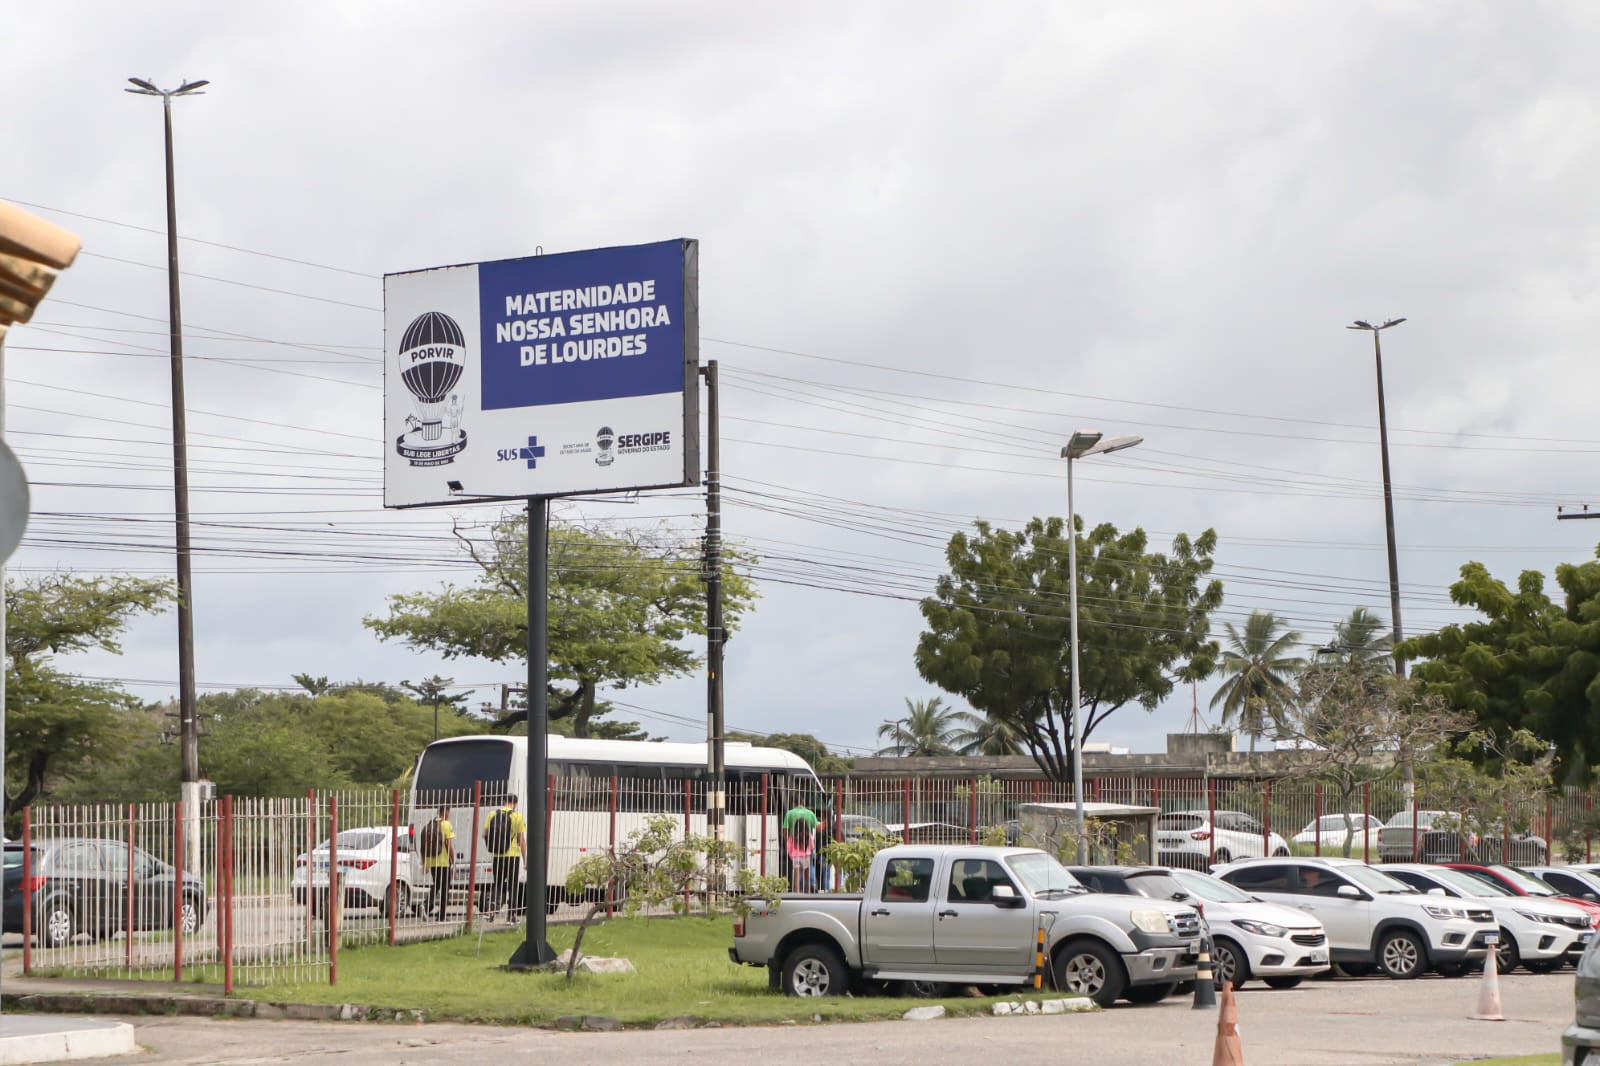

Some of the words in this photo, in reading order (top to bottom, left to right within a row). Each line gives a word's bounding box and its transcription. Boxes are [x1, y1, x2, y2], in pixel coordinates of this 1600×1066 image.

[505, 279, 655, 316] MATERNIDADE
[496, 316, 566, 343] NOSSA
[570, 305, 670, 334] SENHORA
[411, 347, 454, 362] PORVIR
[520, 344, 547, 367] DE
[552, 334, 647, 364] LOURDES
[618, 431, 670, 448] SERGIPE
[497, 448, 518, 461] SUS
